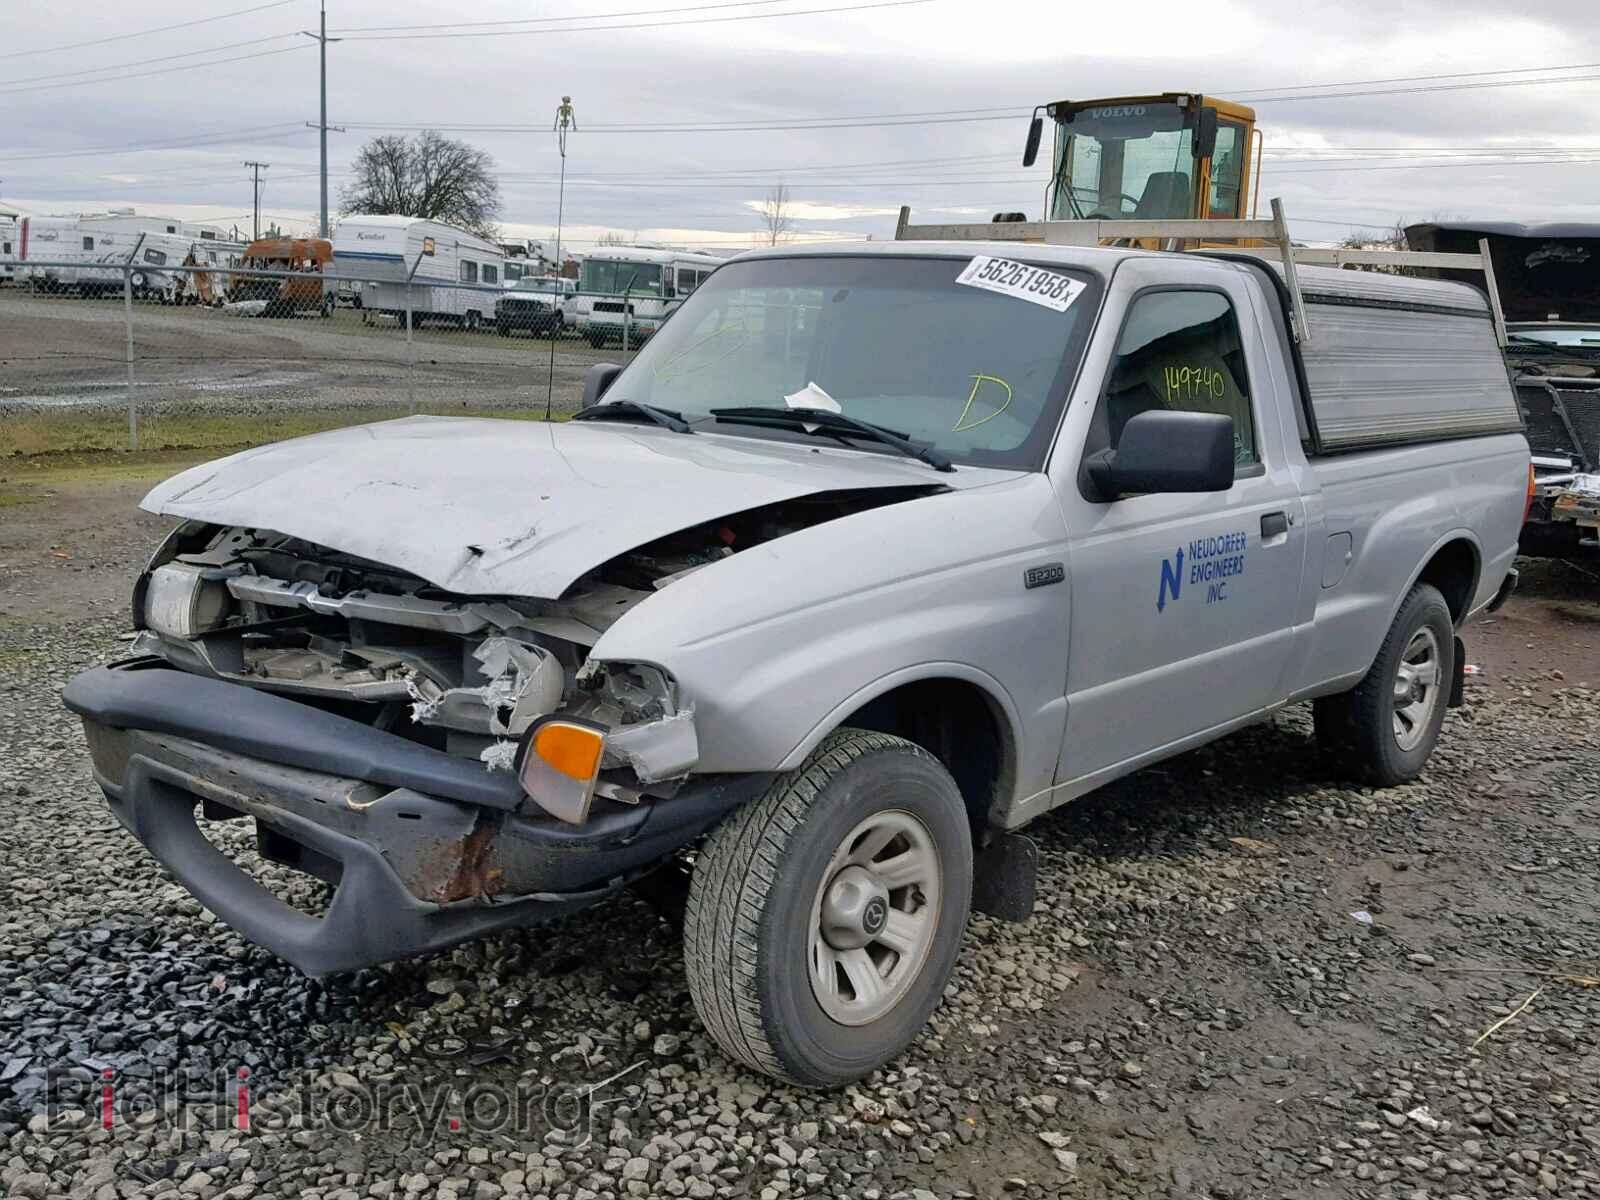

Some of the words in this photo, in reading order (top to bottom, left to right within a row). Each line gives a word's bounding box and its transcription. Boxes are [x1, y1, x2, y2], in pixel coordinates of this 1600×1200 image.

[1093, 106, 1146, 119] VOLVO
[1165, 366, 1224, 400] 149740
[953, 374, 1012, 432] D
[1189, 532, 1247, 560] NEUDORFER
[1191, 555, 1244, 584] ENGINEERS
[1207, 582, 1227, 604] INC.
